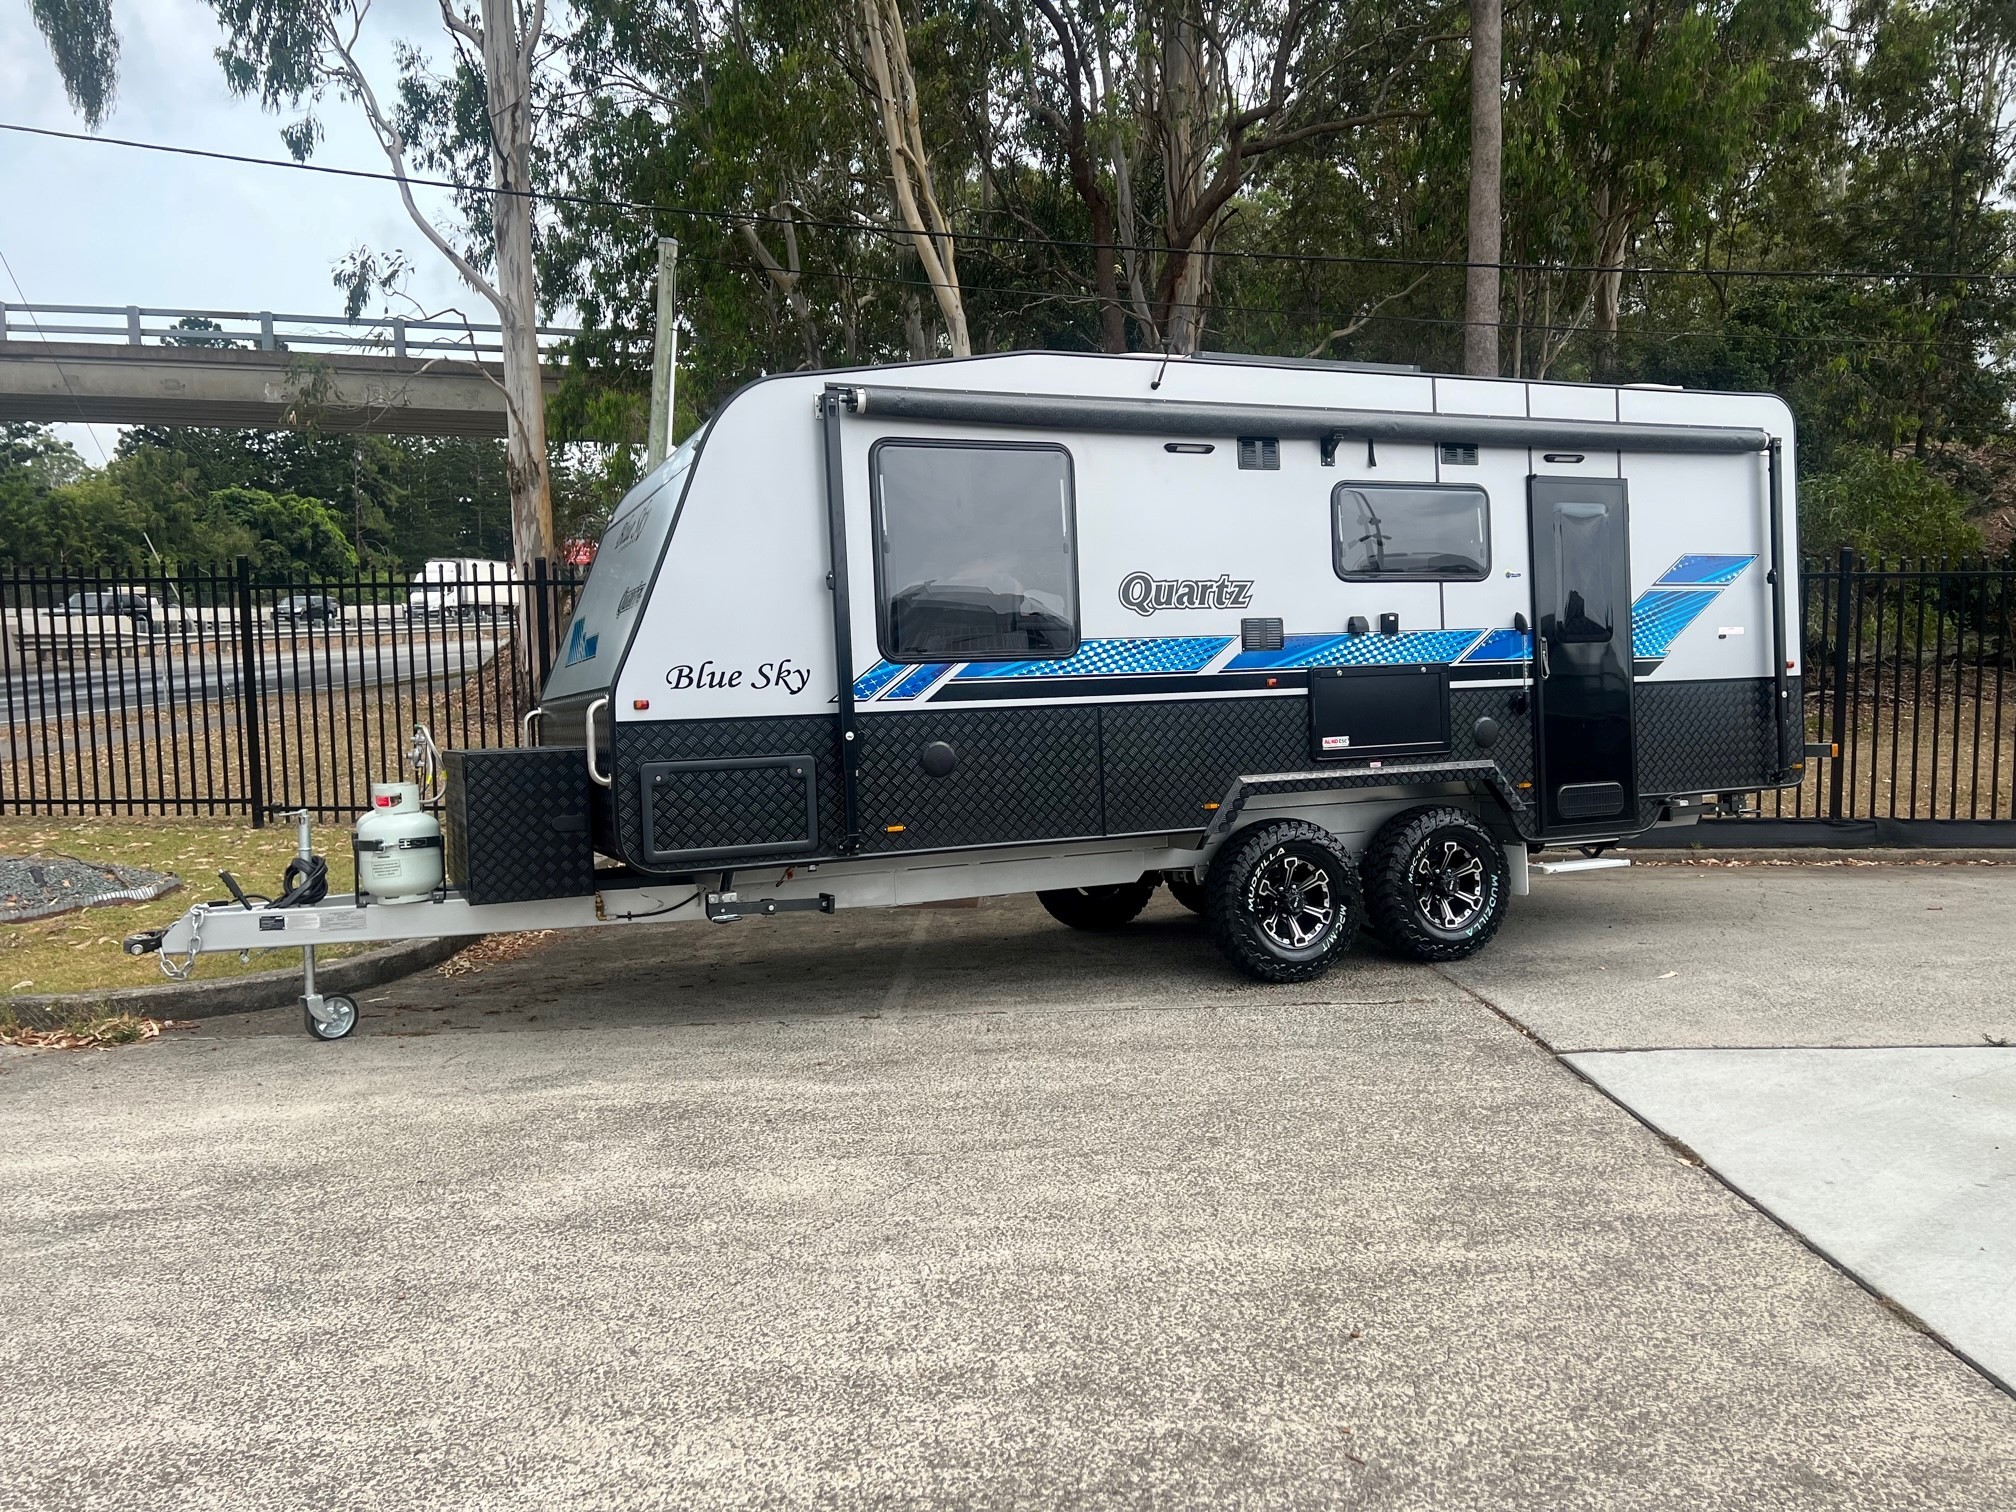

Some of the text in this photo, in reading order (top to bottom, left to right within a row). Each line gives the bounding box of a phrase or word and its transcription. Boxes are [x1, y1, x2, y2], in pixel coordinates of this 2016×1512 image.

[1118, 571, 1255, 617] Quartz
[665, 658, 811, 695] Blue Sky
[1247, 847, 1286, 912] MUDZILLA
[1465, 874, 1499, 937] MUDZILLA
